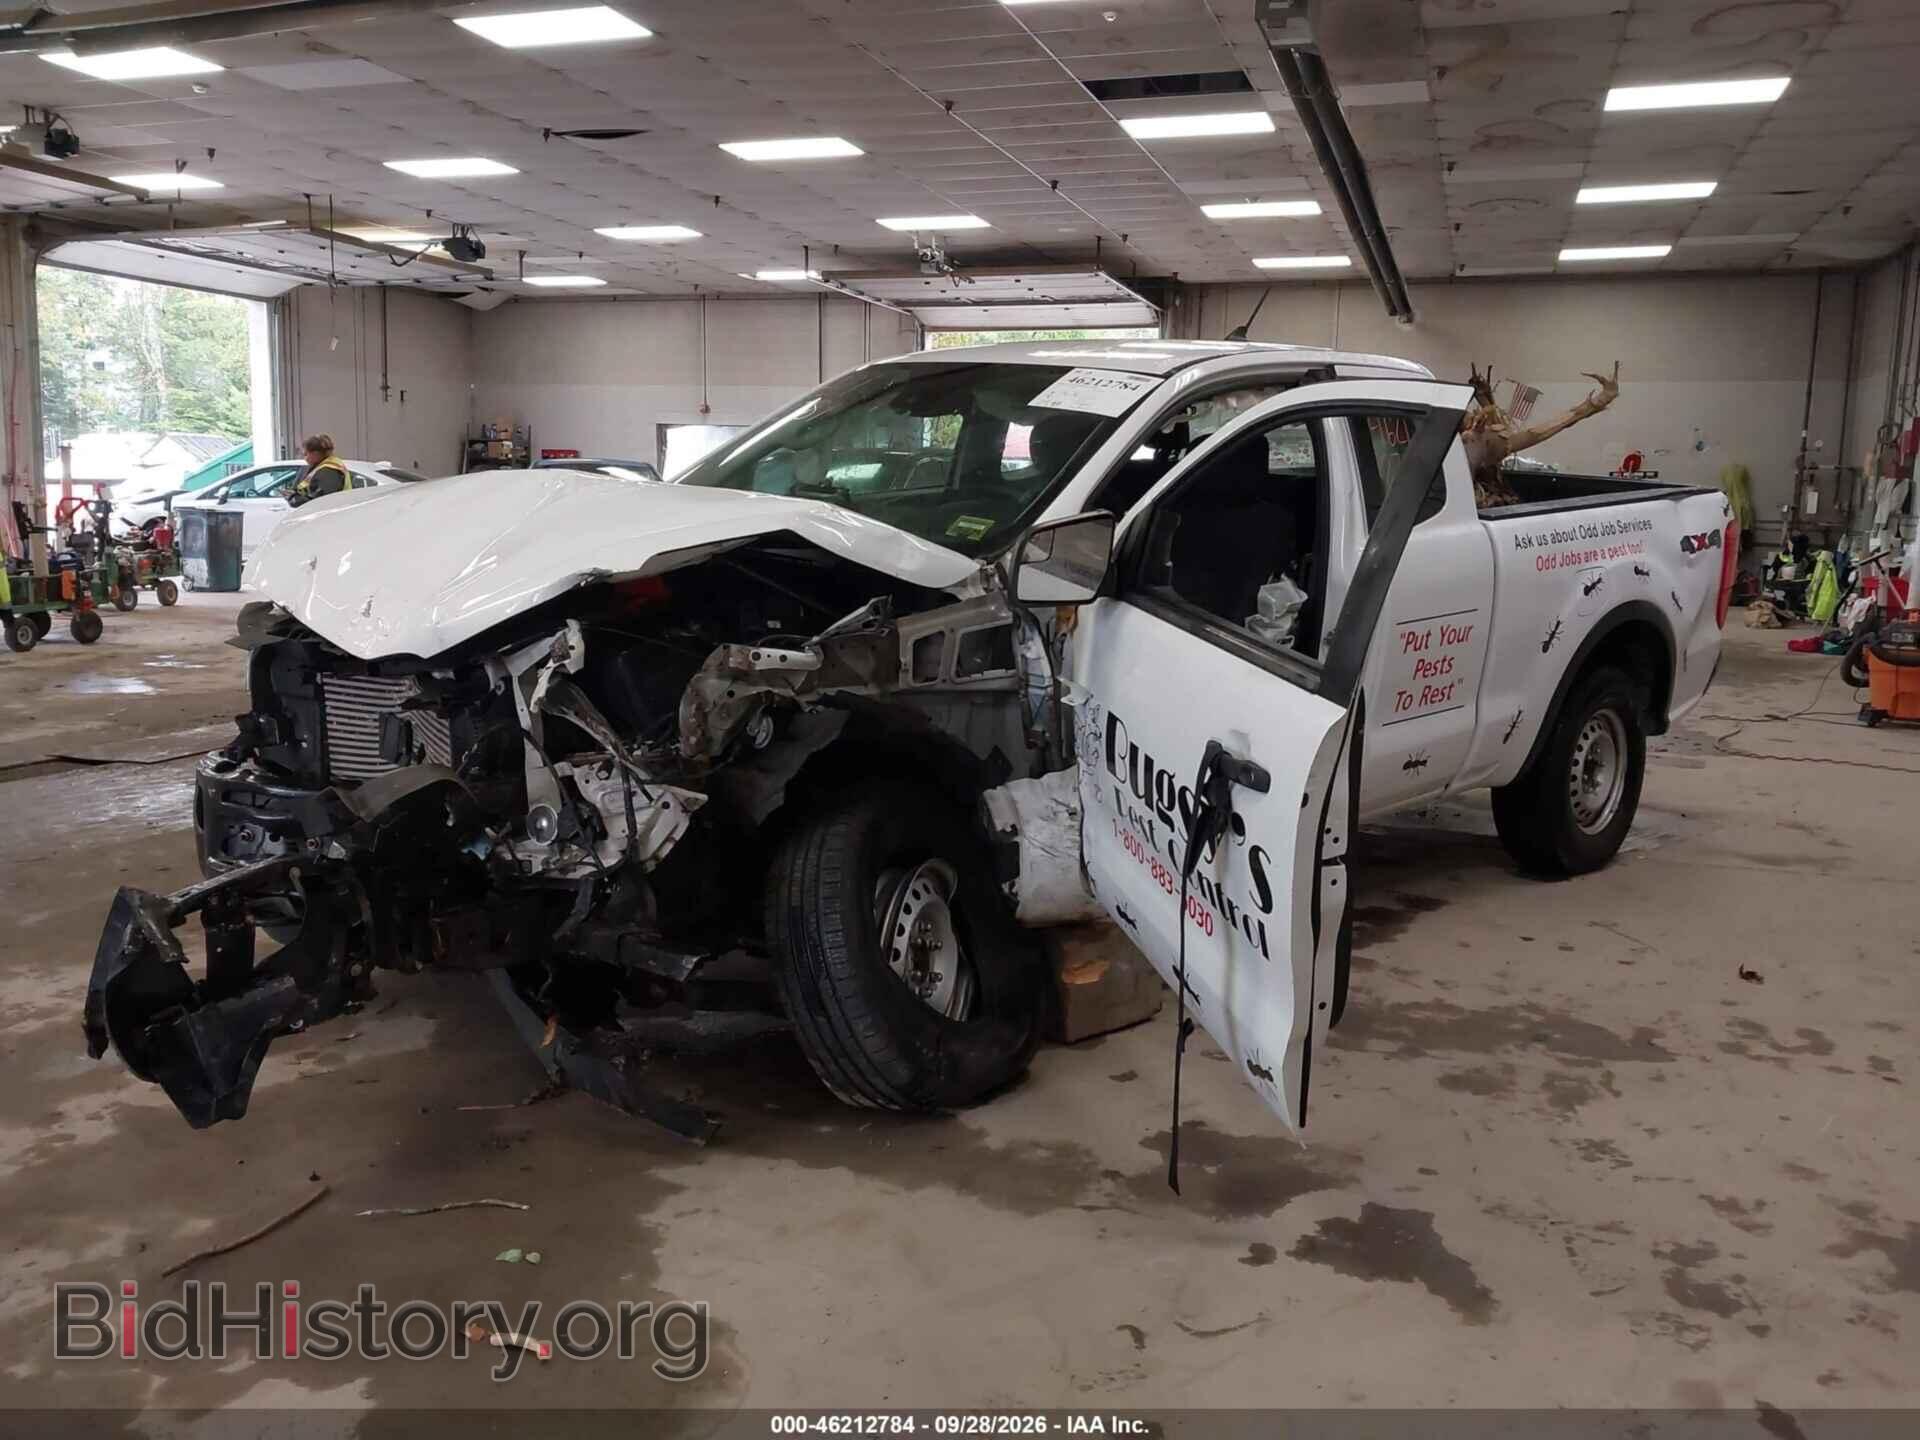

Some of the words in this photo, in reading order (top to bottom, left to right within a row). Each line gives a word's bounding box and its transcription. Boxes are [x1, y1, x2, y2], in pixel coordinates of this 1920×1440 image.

[1067, 376, 1140, 392] 46212784
[1514, 534, 1534, 551] Ask
[1536, 534, 1549, 546] us
[1550, 527, 1579, 545] about
[1579, 521, 1599, 540] Odd
[1600, 519, 1617, 537] Job
[1617, 517, 1653, 534] Services
[1536, 554, 1557, 572] Odd
[1559, 549, 1582, 567] Jobs
[1583, 549, 1599, 562] are
[1600, 549, 1607, 559] a
[1608, 544, 1628, 561] pest
[1400, 630, 1431, 654] "Put
[1439, 624, 1474, 648] Your
[1412, 656, 1455, 681] Pests
[1394, 690, 1413, 713] To
[1112, 818, 1214, 937] 1-800-883-030
